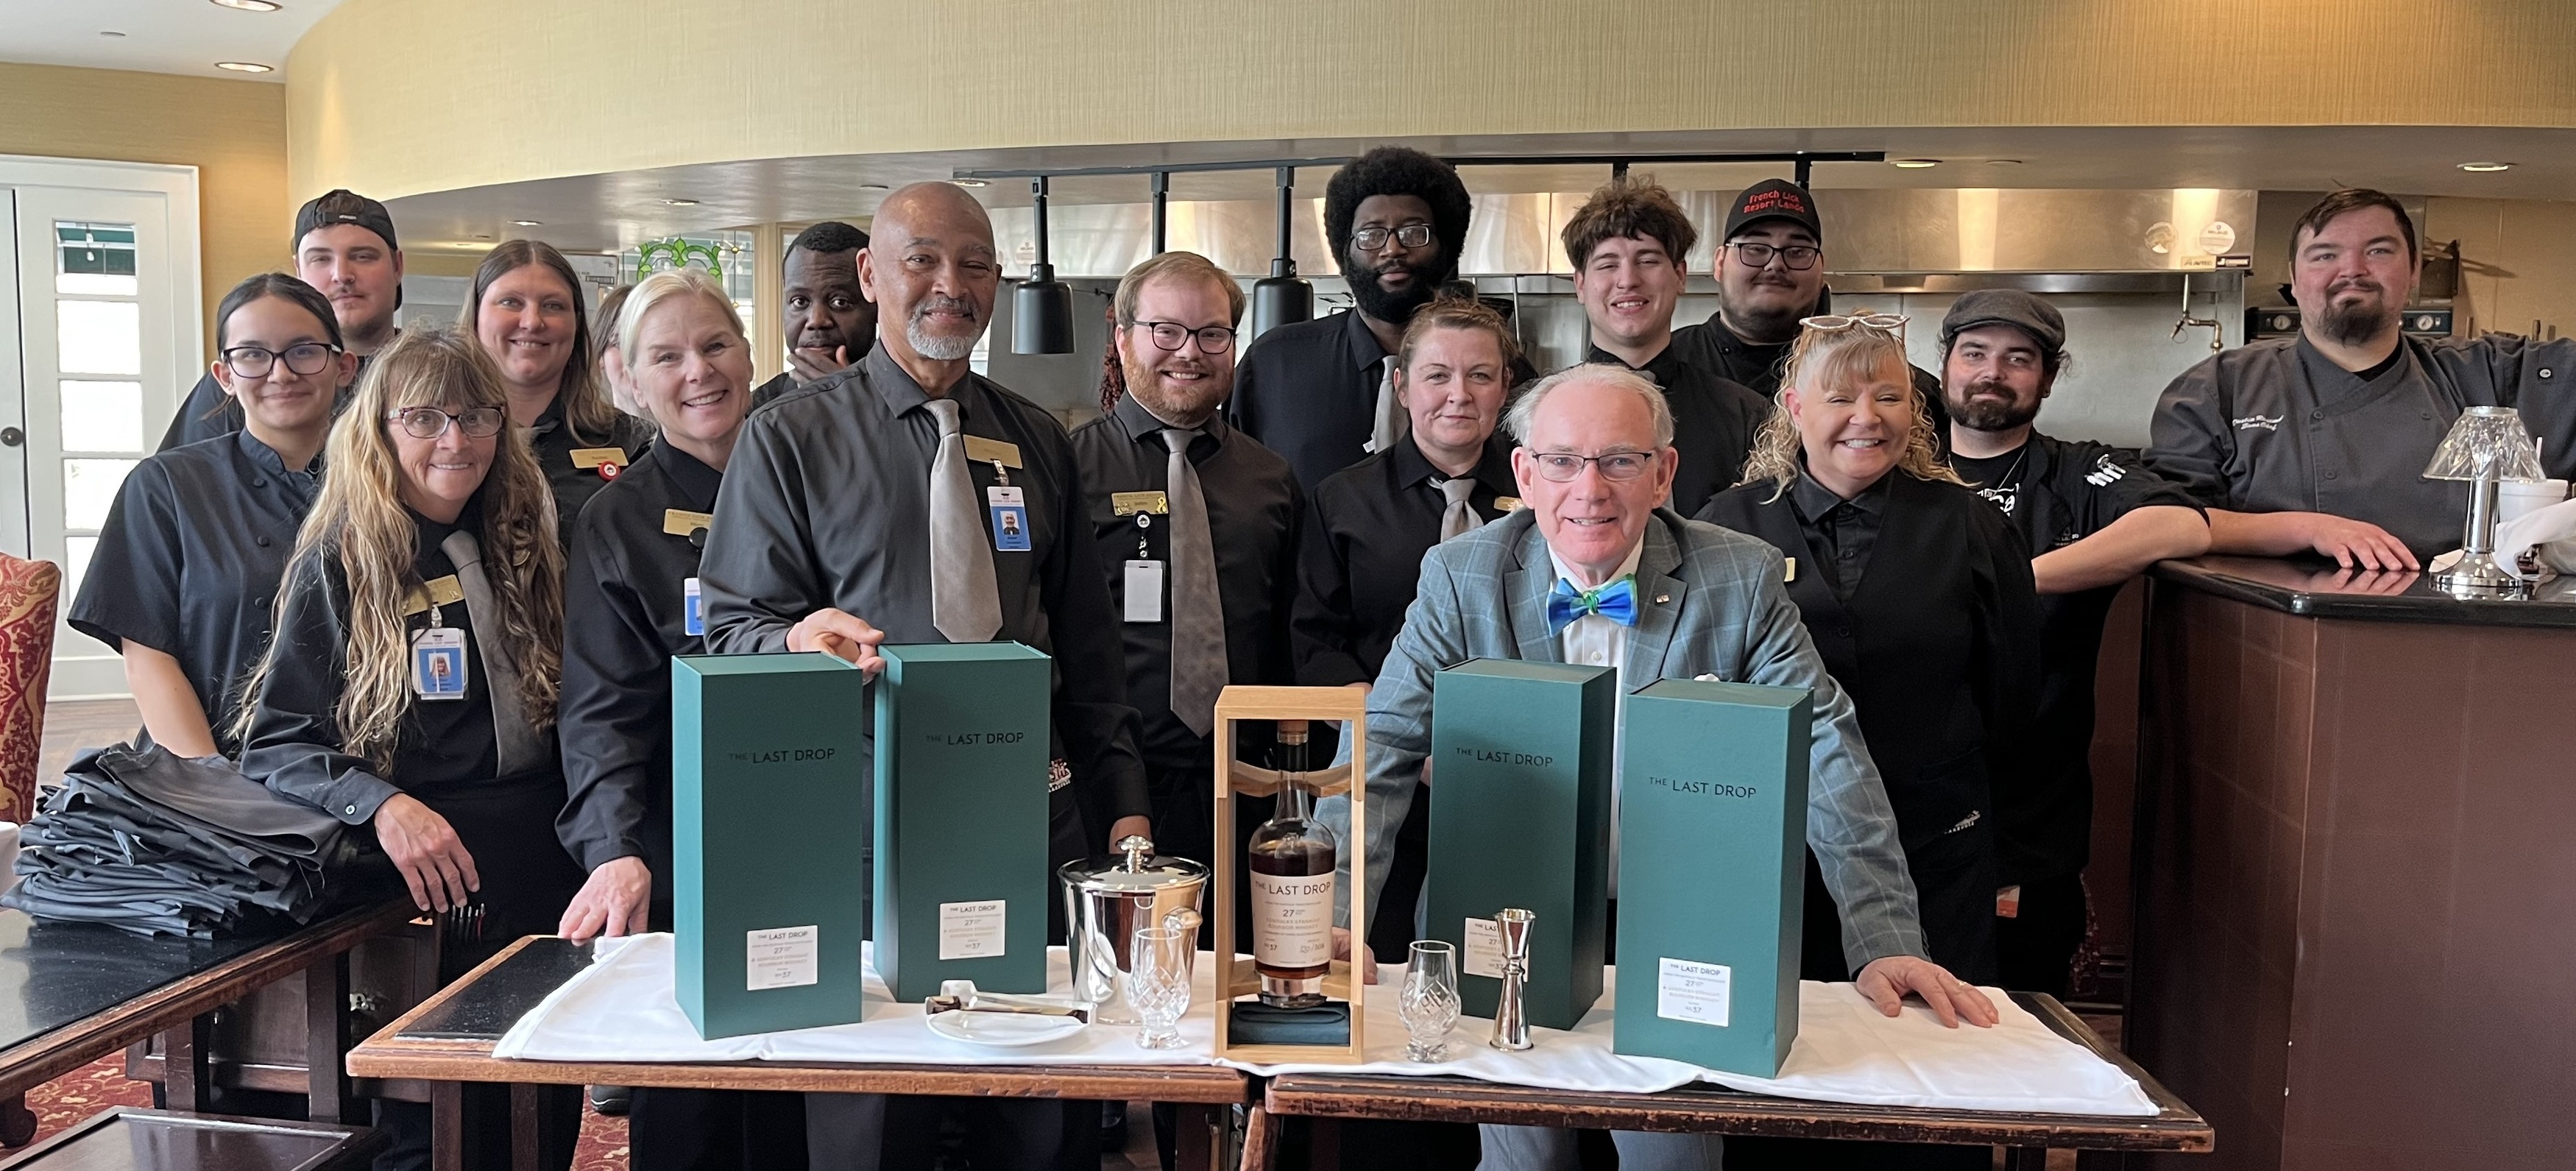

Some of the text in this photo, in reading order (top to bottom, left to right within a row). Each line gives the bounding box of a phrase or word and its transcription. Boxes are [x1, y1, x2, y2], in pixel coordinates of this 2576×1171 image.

[1749, 190, 1800, 204] French Lick
[1744, 199, 1774, 213] Resort
[926, 732, 1025, 746] THE LAST DROP
[729, 748, 835, 764] THE LAST DROP
[1456, 747, 1554, 768] THE LAST DROP
[1649, 776, 1757, 799] THE LAST DROP
[1255, 880, 1331, 896] THE LAST DROP
[960, 905, 977, 913] LAST
[1282, 909, 1295, 918] 27
[1485, 924, 1497, 932] LAS
[768, 932, 786, 941] LAST
[788, 930, 809, 938] DROP
[774, 947, 784, 955] 27
[1680, 964, 1699, 974] LAST
[1700, 967, 1721, 976] DROP
